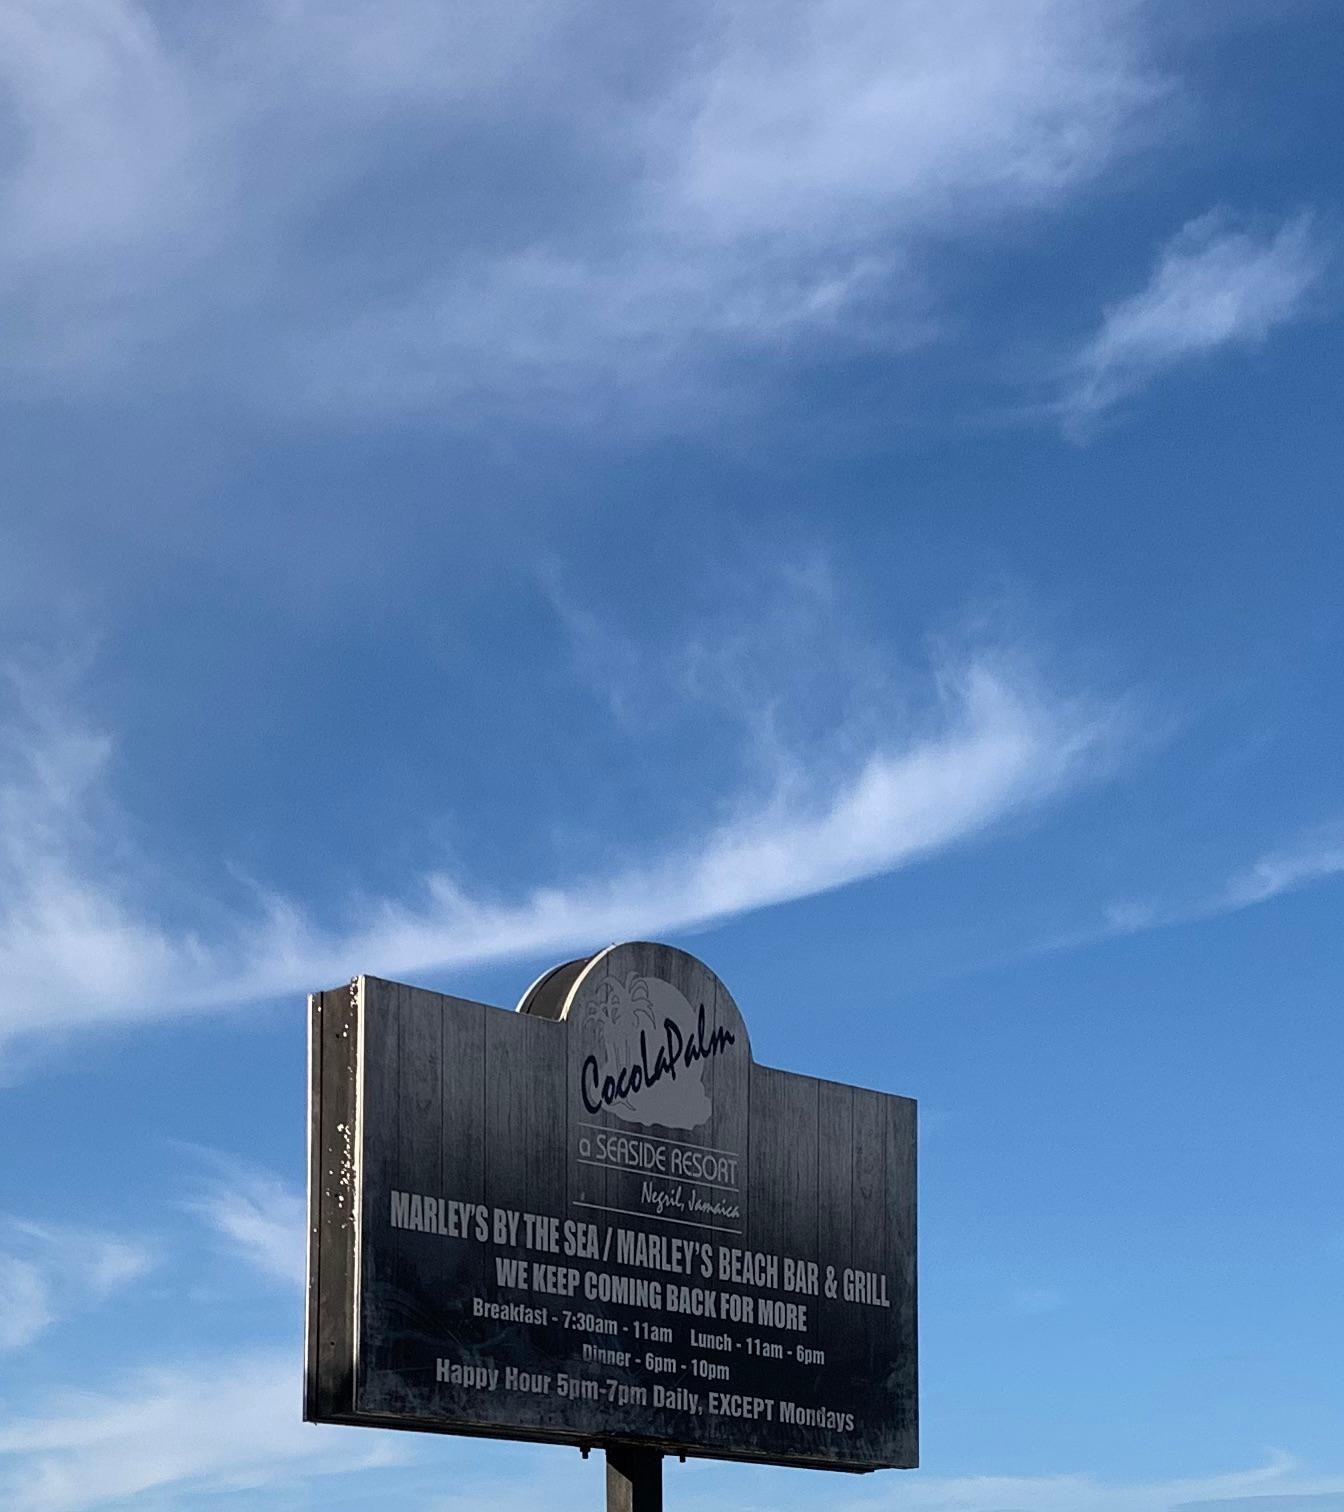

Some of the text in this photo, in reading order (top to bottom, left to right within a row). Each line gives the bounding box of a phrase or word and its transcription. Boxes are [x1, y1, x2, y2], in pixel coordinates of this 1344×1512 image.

[596, 1134, 666, 1172] SEASIDE
[671, 1148, 738, 1185] RESORT
[688, 1192, 740, 1218] Jamaica
[390, 1190, 489, 1242] MARLEY'S
[493, 1208, 520, 1247] BY
[523, 1213, 560, 1254] THE
[564, 1219, 600, 1260] SEA
[616, 1228, 713, 1278] MARLEY'S
[718, 1246, 778, 1289] BEACH
[783, 1257, 819, 1296] BAR
[824, 1265, 838, 1299] &
[843, 1268, 891, 1308] GRILL
[495, 1257, 807, 1331] WE KEEP COMING BACK FOR MORE
[472, 1297, 548, 1326] Breakfast
[562, 1310, 618, 1336] 7:30am
[633, 1320, 673, 1343] 11am
[690, 1329, 732, 1352] Lunch
[746, 1337, 783, 1359] 11am
[796, 1344, 825, 1366] 6pm
[582, 1343, 631, 1368] Dinner
[645, 1352, 677, 1374] 6pm
[691, 1359, 730, 1381] 10pm
[436, 1358, 855, 1433] Happy Hour 5pm-7pm Daily, EXCEPT Mondays
